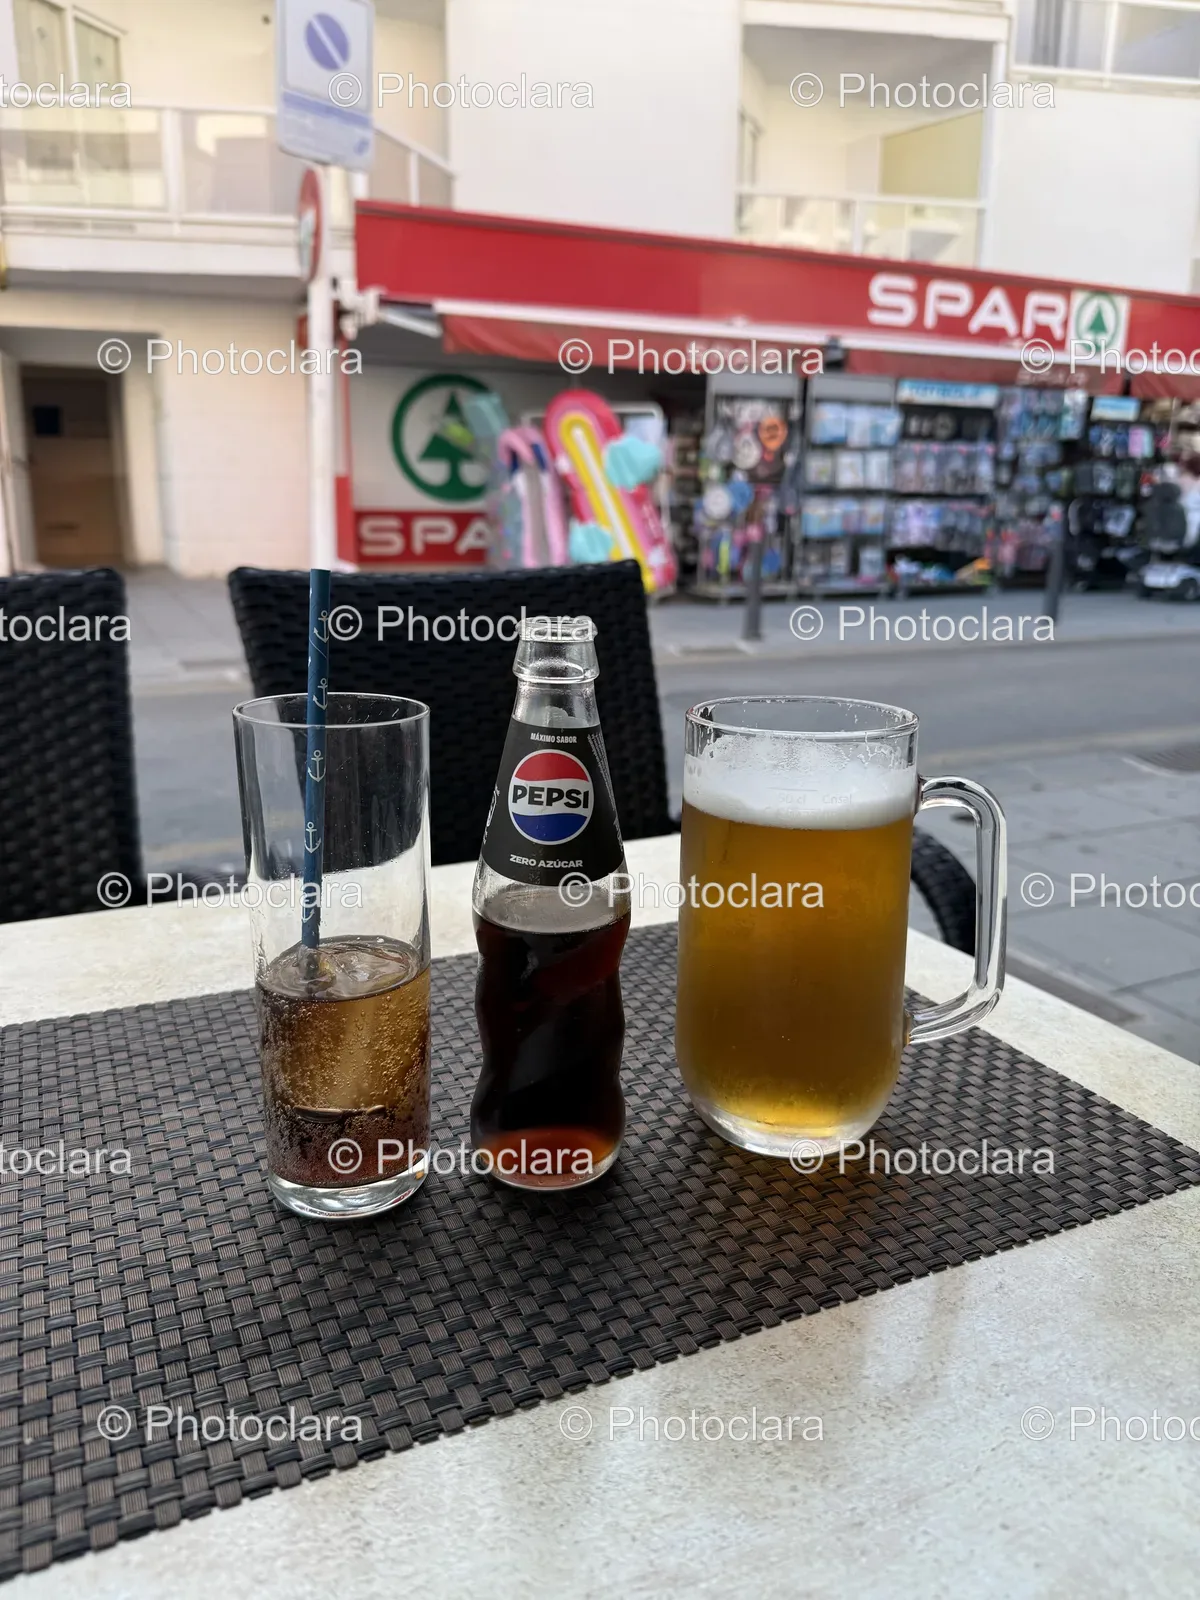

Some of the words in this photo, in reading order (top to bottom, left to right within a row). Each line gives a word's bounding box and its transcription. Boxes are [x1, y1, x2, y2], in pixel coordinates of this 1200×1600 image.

[867, 272, 1068, 341] SPAR
[358, 515, 493, 556] SPA
[530, 732, 556, 743] MÁXIMO
[556, 735, 578, 744] SABOR
[512, 784, 590, 809] PEPSI
[510, 853, 537, 867] ZERO
[538, 858, 583, 868] AZÚCAR
